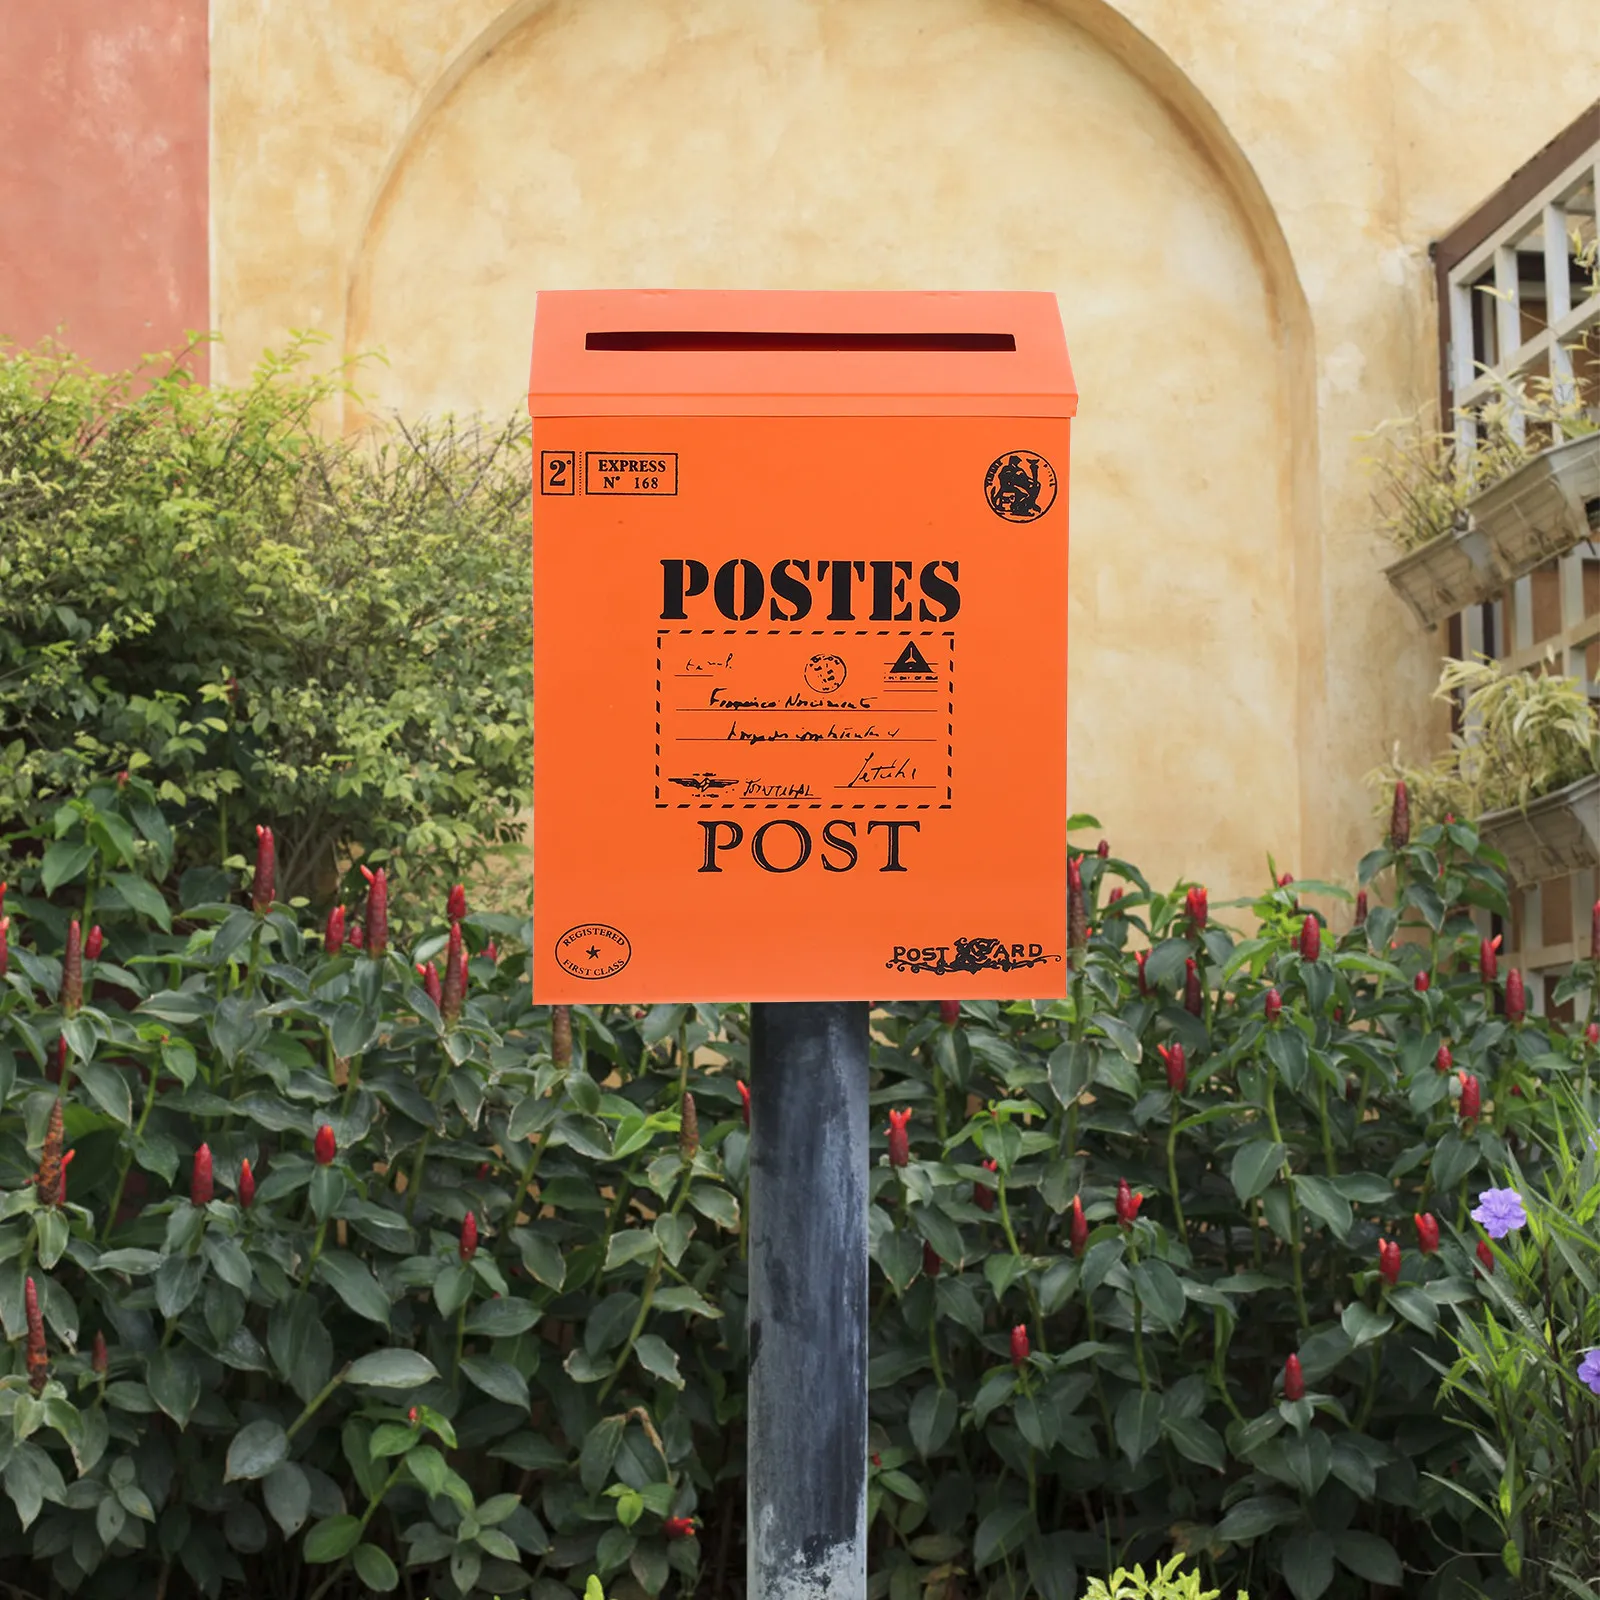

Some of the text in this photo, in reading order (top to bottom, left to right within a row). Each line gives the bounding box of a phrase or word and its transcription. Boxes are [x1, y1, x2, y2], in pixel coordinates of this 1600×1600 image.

[598, 459, 666, 472] EXPRESS
[634, 477, 659, 489] 168
[659, 558, 961, 622] POSTES
[697, 819, 921, 873] POST
[562, 927, 626, 948] REGISTERED
[893, 946, 950, 963] POST
[562, 958, 625, 977] FIRST CLASS
